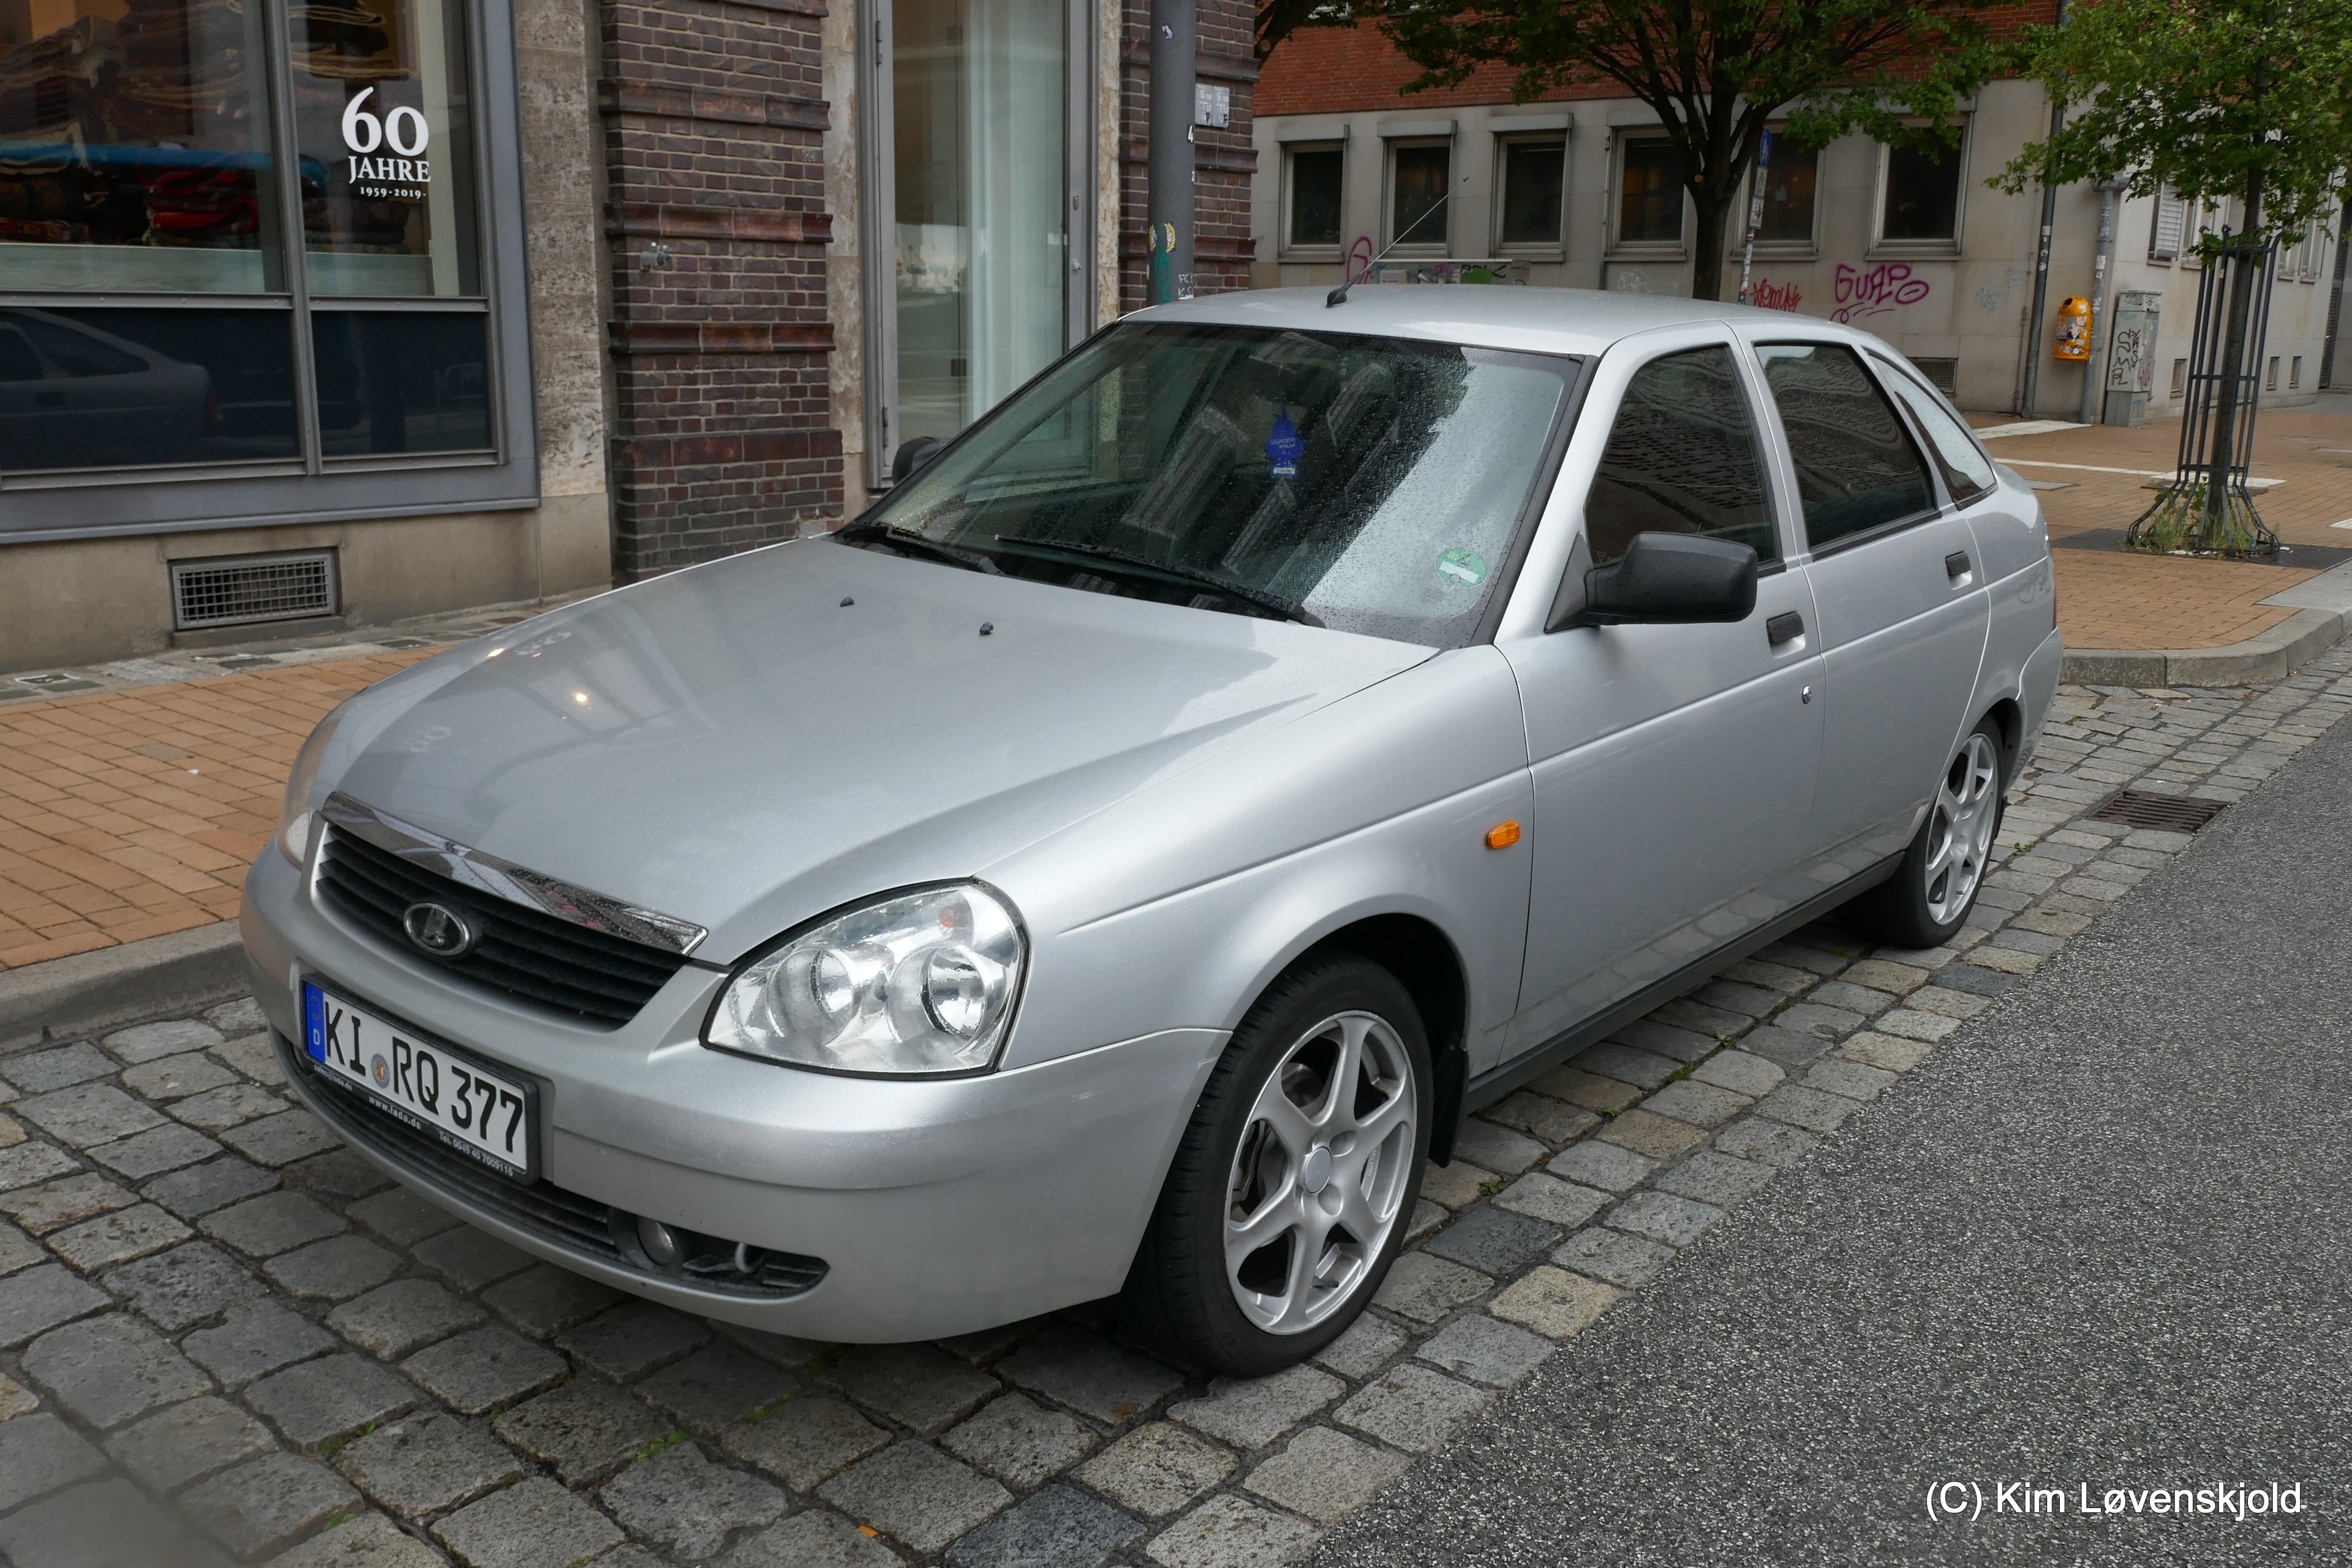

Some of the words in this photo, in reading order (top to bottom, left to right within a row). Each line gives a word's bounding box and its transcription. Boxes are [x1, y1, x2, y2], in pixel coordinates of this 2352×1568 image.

[342, 86, 429, 157] 60
[348, 156, 431, 184] JAHRE
[313, 1029, 320, 1046] D
[325, 1001, 366, 1077] KI
[392, 1036, 439, 1116] RQ
[451, 1065, 523, 1153] 377
[369, 1095, 421, 1130] www.lada.de
[439, 1130, 453, 1145] Tel.
[472, 1148, 481, 1159] 40
